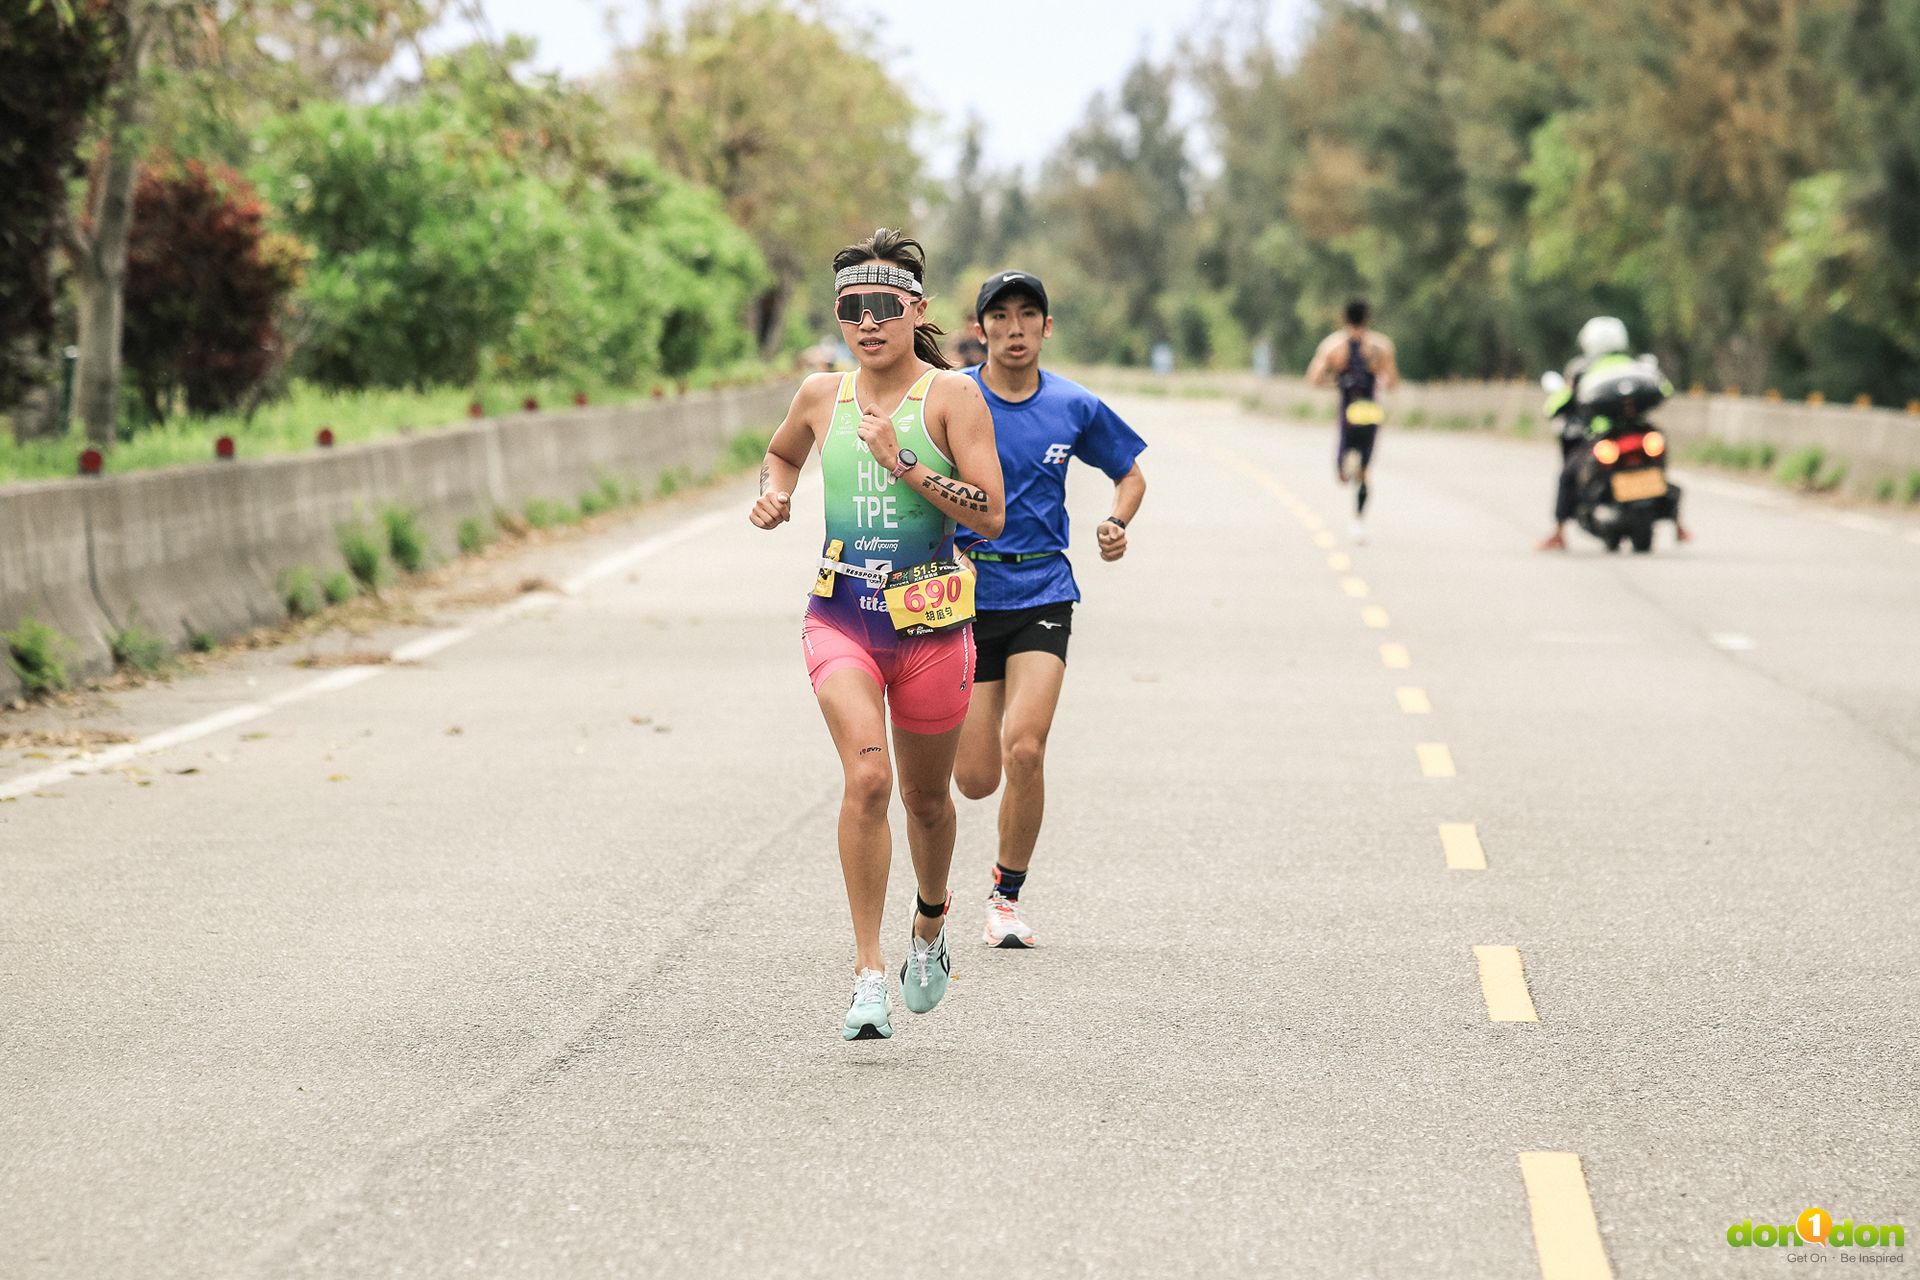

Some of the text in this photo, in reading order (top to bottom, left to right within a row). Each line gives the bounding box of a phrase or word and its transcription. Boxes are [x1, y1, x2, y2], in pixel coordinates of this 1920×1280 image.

[858, 461, 888, 492] HU
[852, 496, 898, 529] TPE
[913, 562, 938, 577] 51.5
[904, 575, 962, 613] 690
